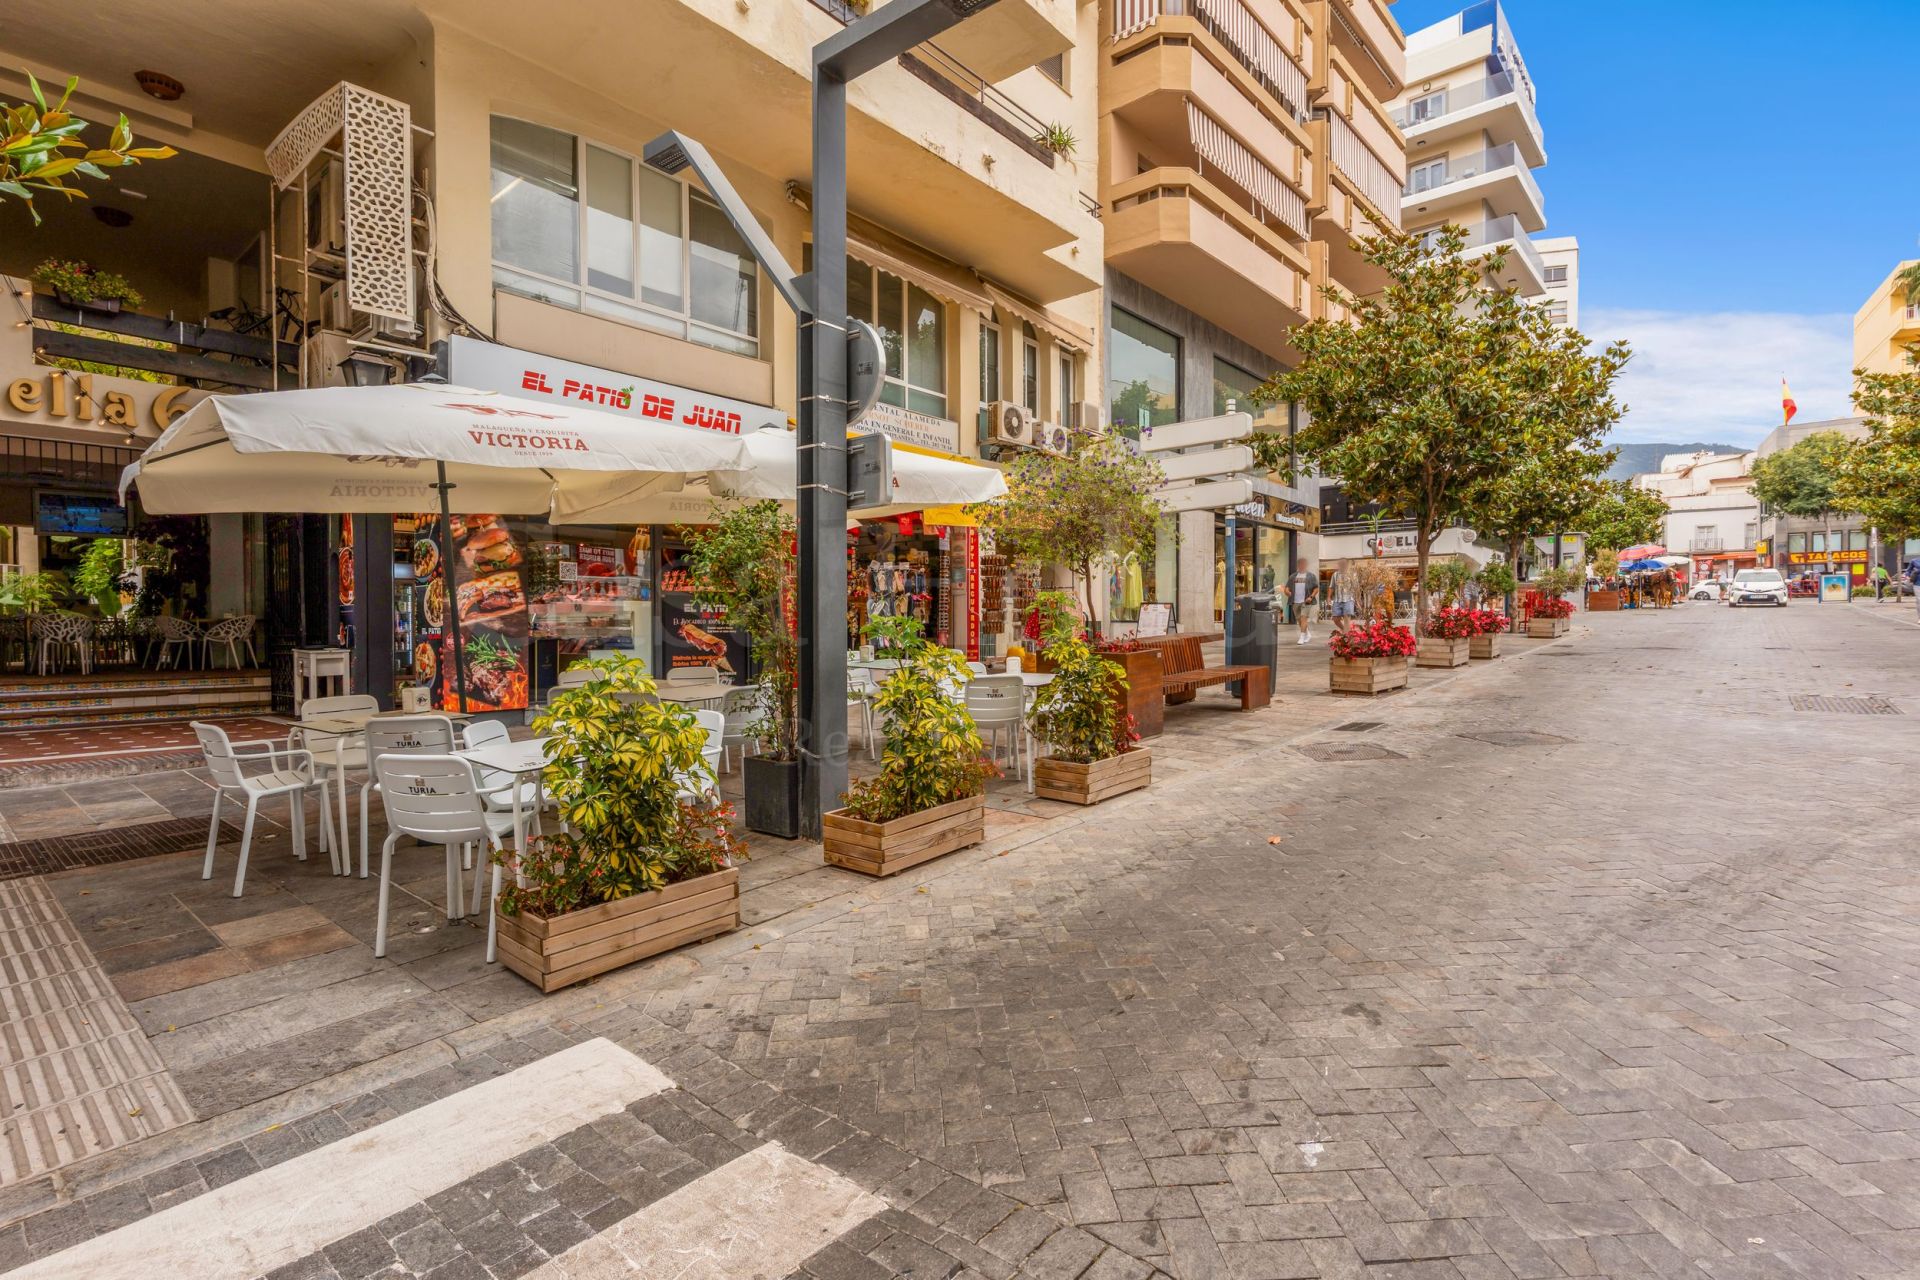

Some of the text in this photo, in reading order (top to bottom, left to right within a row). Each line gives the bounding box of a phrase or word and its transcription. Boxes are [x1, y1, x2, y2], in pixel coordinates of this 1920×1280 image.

[521, 370, 742, 435] EL PATIO DE JUAN
[874, 404, 941, 426] ENTAL ALAMEDA
[467, 430, 590, 452] VICTORIA
[882, 423, 916, 438] GENERAL
[922, 432, 952, 445] INFANTIL
[408, 786, 436, 794] TURIA
